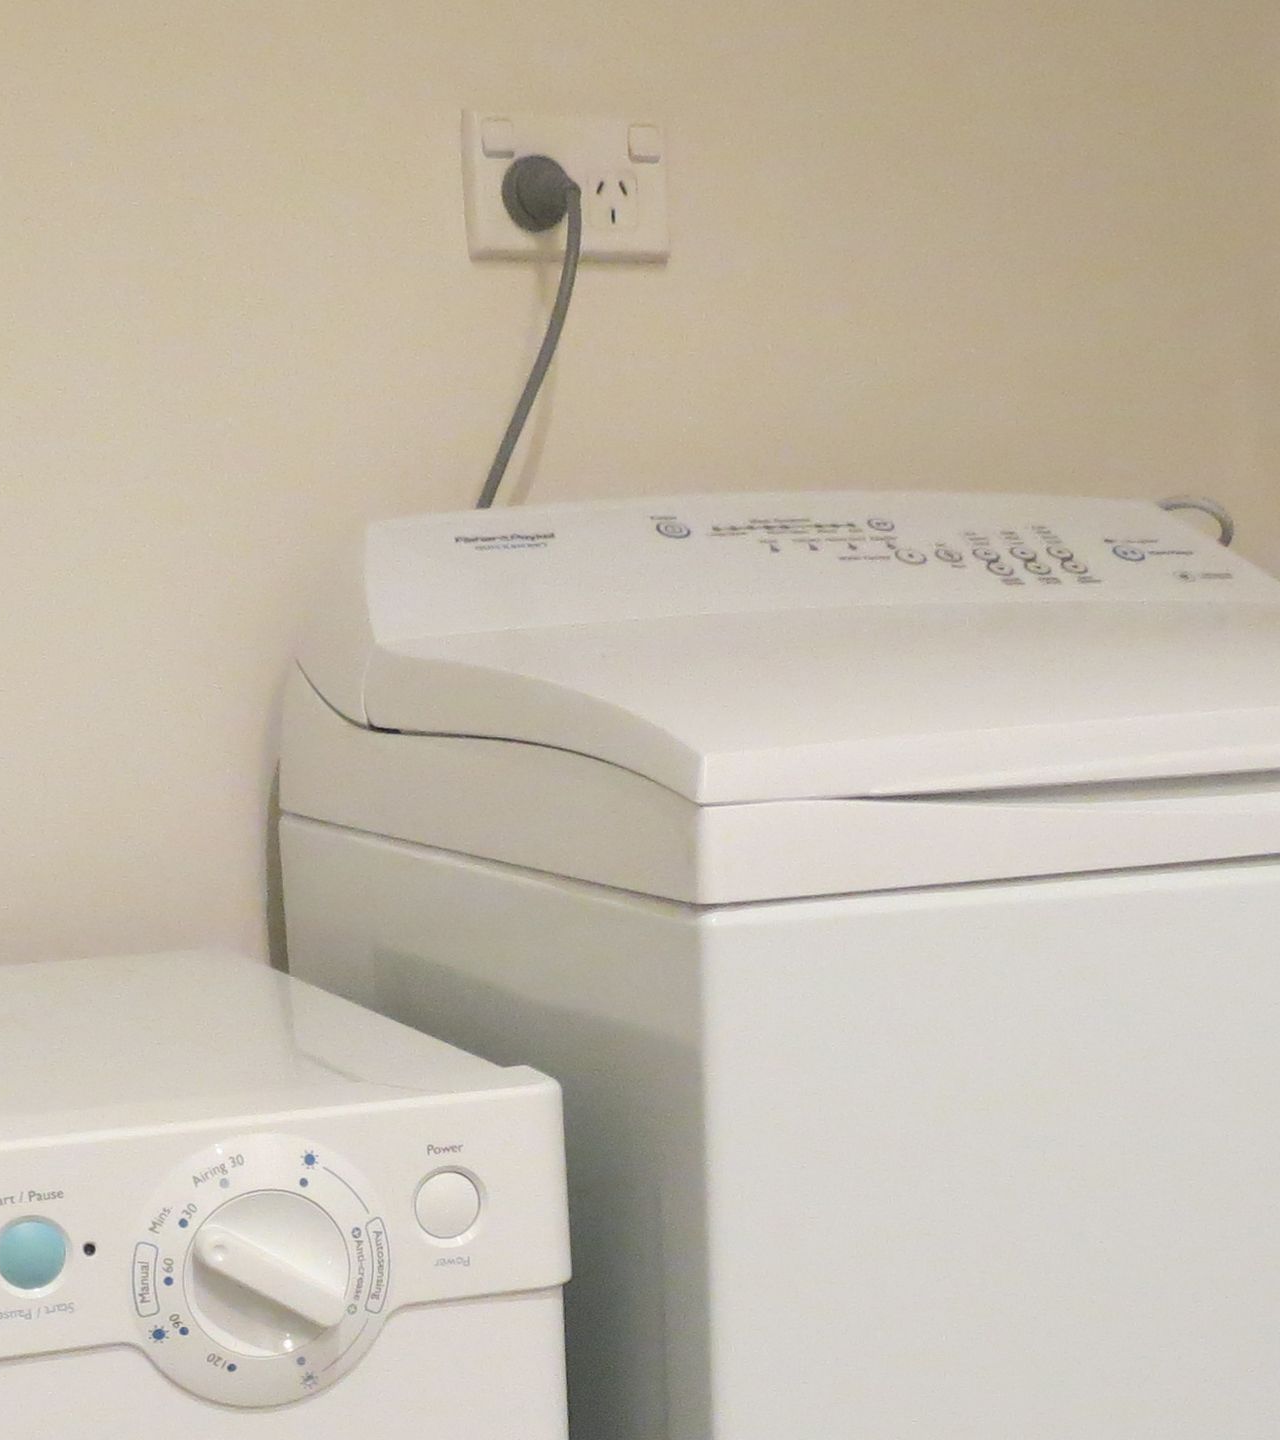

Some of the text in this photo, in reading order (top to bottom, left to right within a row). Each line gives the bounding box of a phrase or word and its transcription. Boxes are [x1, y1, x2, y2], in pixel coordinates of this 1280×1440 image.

[426, 1143, 464, 1156] Power
[192, 1153, 245, 1188] Airing 30
[28, 1190, 65, 1203] Pause
[181, 1202, 198, 1220] 30
[148, 1205, 173, 1235] Mins.
[162, 1257, 175, 1274] 60
[370, 1230, 385, 1301] Autosensing
[434, 1255, 471, 1267] Power
[354, 1239, 367, 1301] Anti-crease
[137, 1260, 150, 1304] Manual
[44, 1302, 76, 1315] Start
[168, 1313, 184, 1330] 90
[206, 1352, 228, 1369] 120
